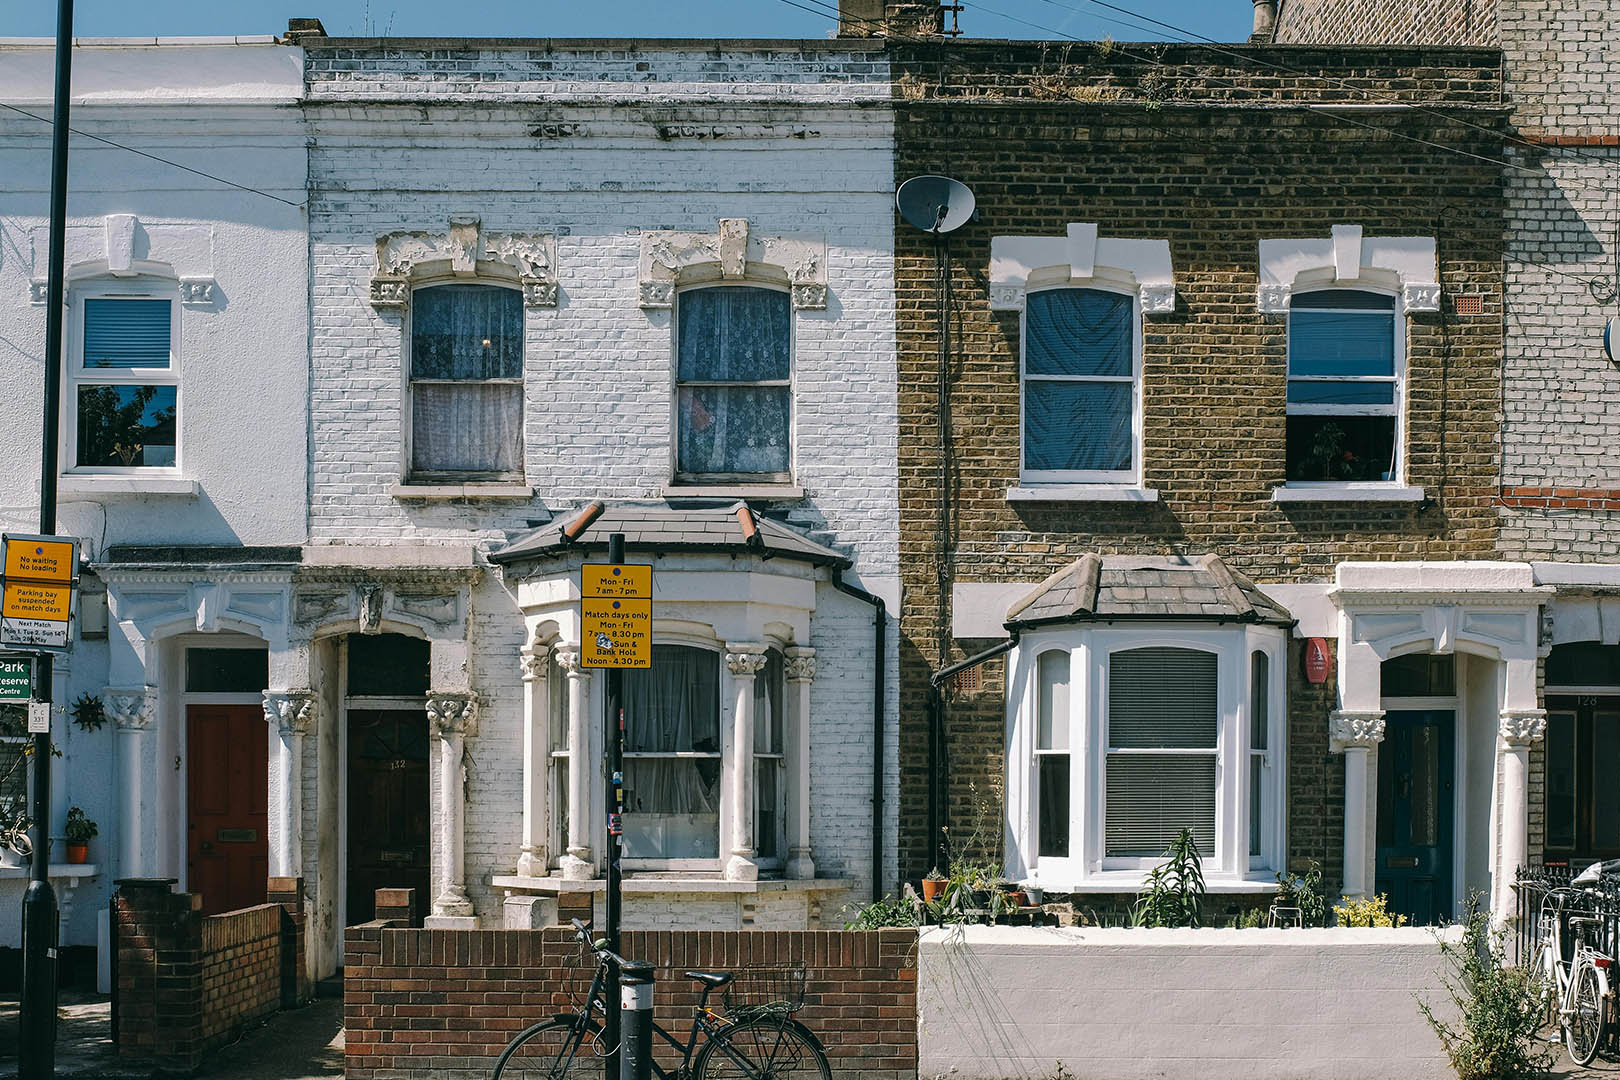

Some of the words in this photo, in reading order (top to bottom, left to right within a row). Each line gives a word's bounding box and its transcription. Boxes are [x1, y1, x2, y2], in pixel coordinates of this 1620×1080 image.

[32, 557, 57, 565] waiting
[32, 564, 57, 573] loading
[17, 589, 43, 598] Parking
[45, 605, 61, 613] days
[611, 611, 630, 620] days
[632, 612, 648, 620] only
[612, 630, 631, 638] 8.30
[614, 640, 629, 648] Sun
[587, 657, 608, 665] Noon
[1577, 695, 1598, 706] 128
[391, 759, 406, 770] 132
